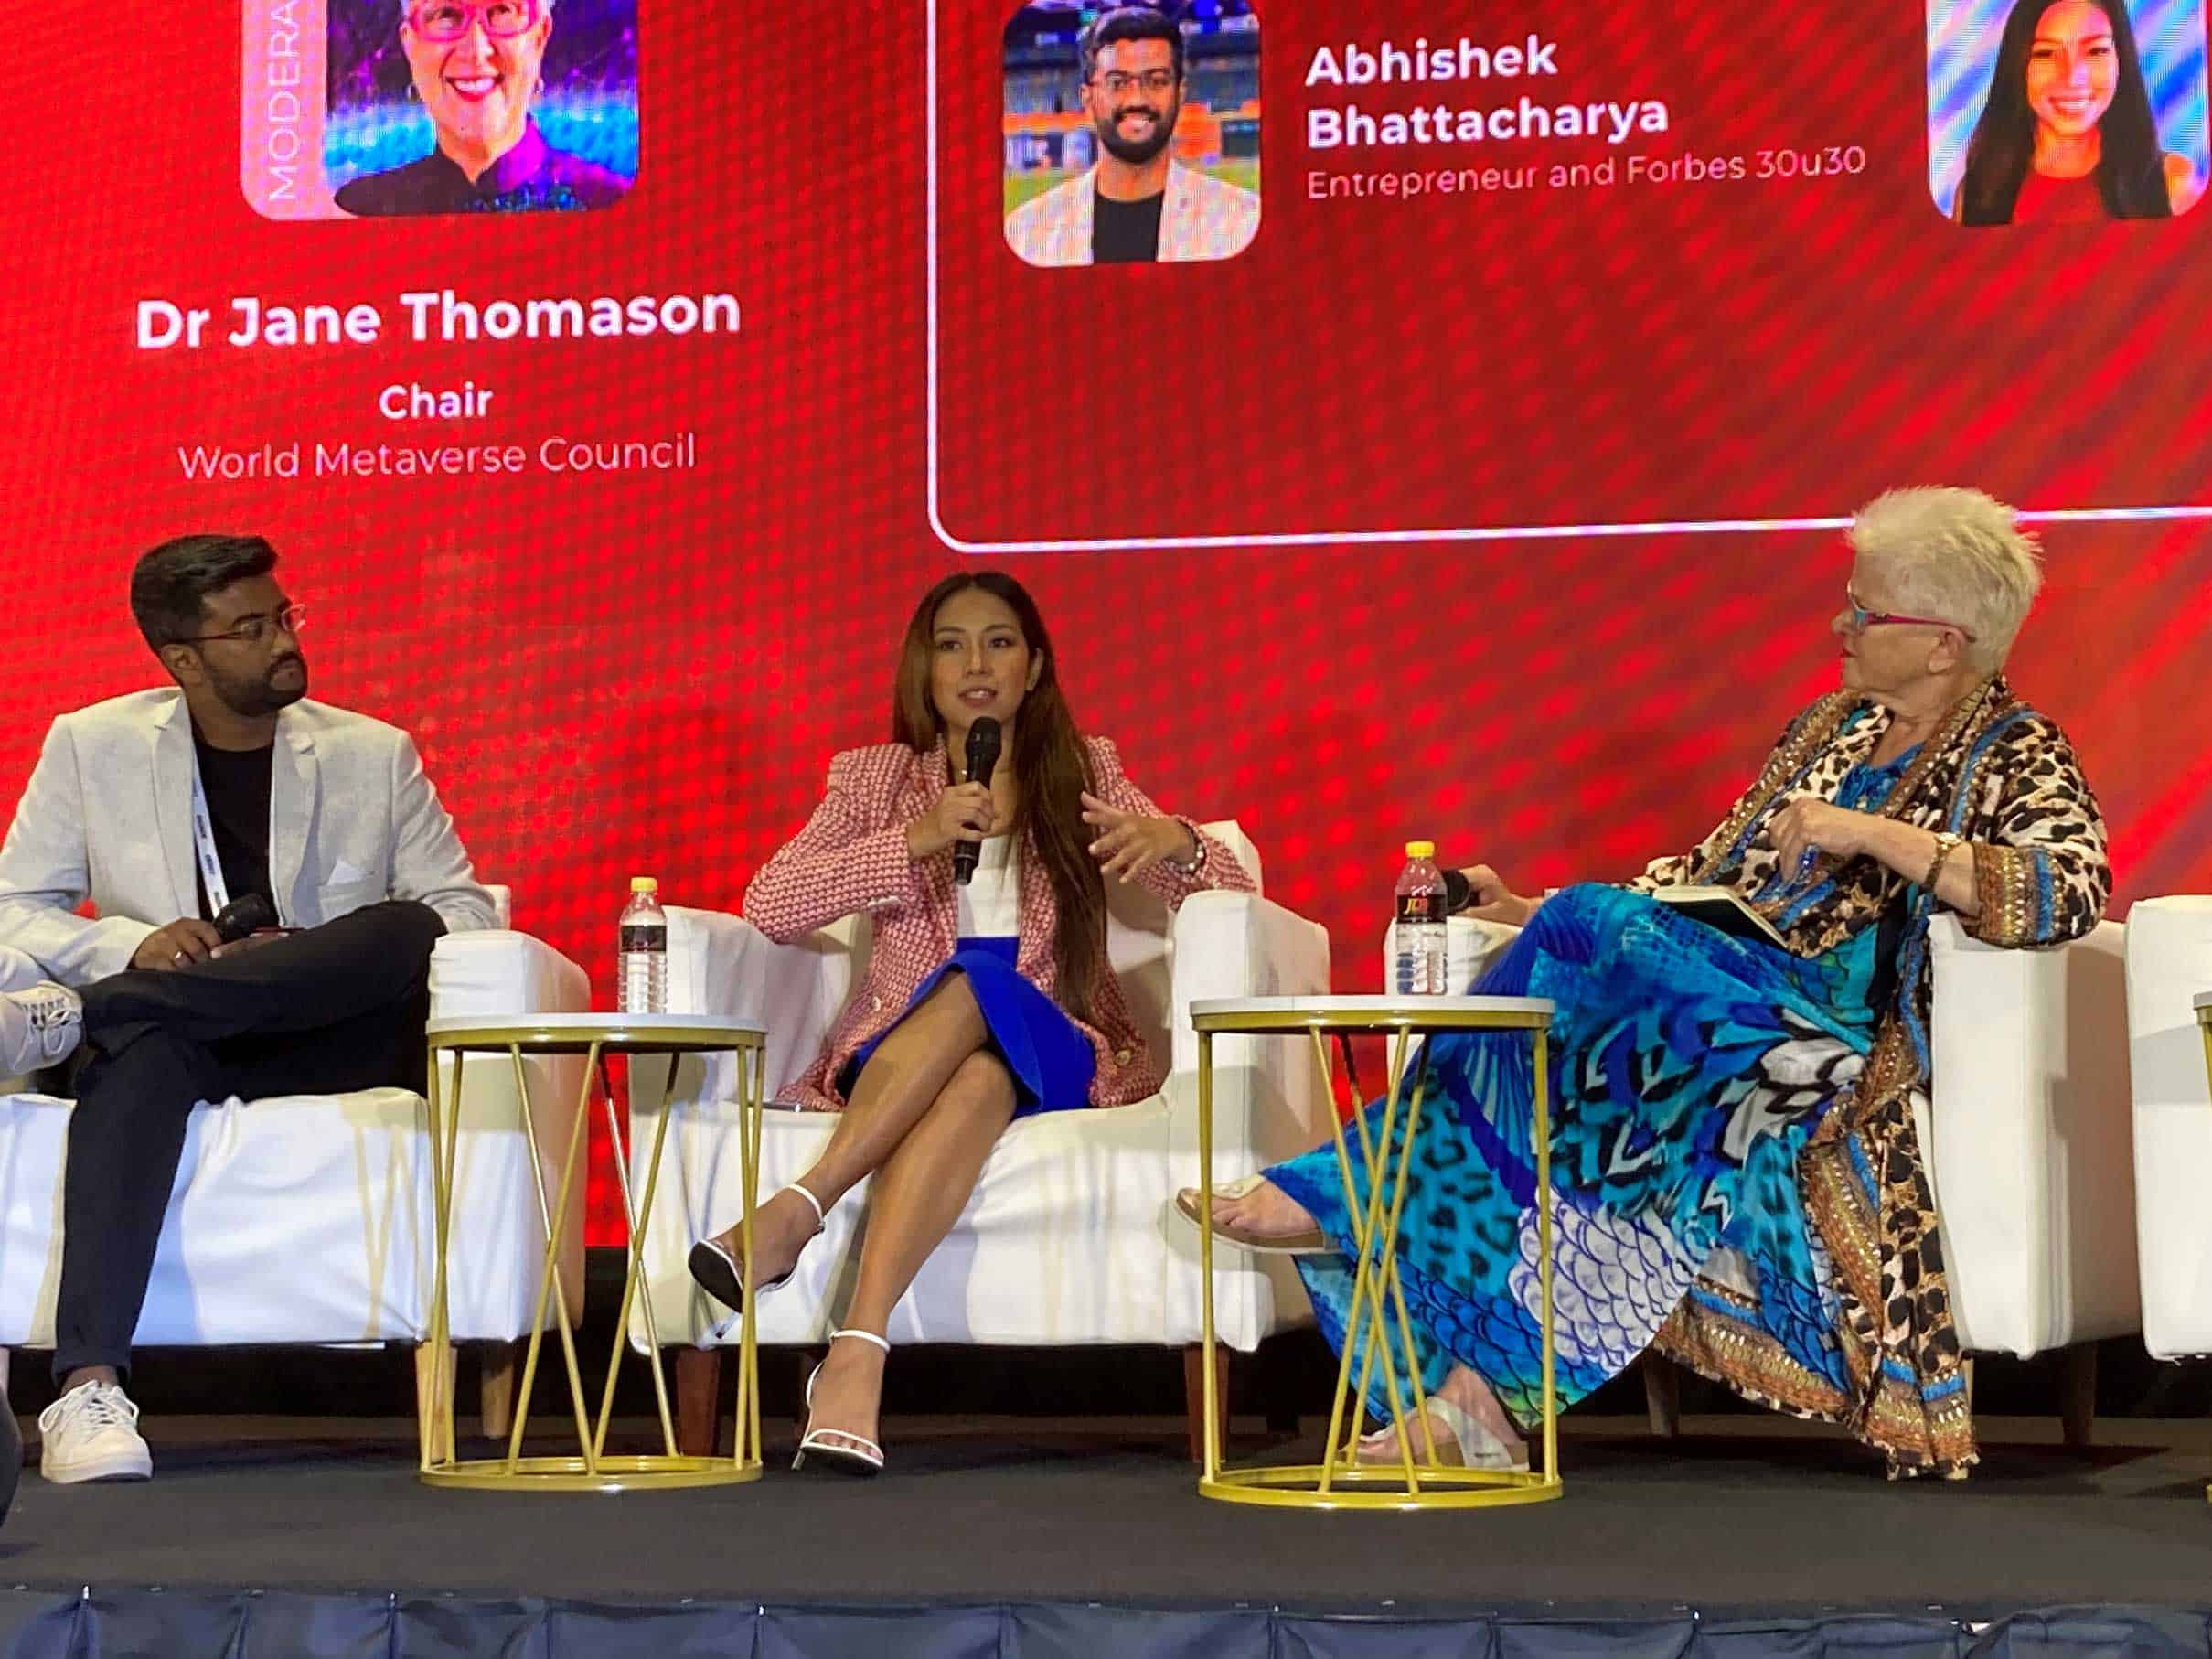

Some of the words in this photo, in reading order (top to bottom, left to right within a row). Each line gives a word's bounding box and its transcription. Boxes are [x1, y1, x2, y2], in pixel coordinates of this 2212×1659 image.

[1305, 34, 1558, 86] Abhishek
[1307, 96, 1668, 148] Bhattacharya
[1308, 166, 1536, 200] Entrepreneur
[1549, 155, 1615, 187] and
[1627, 151, 1746, 183] Forbes
[1756, 145, 1866, 178] 30u30
[136, 300, 209, 349] Dr
[229, 298, 380, 347] Jane
[400, 291, 742, 342] Thomason
[379, 381, 494, 421] Chair
[177, 443, 299, 480] World
[315, 439, 527, 476] Metaverse
[539, 433, 696, 473] Council
